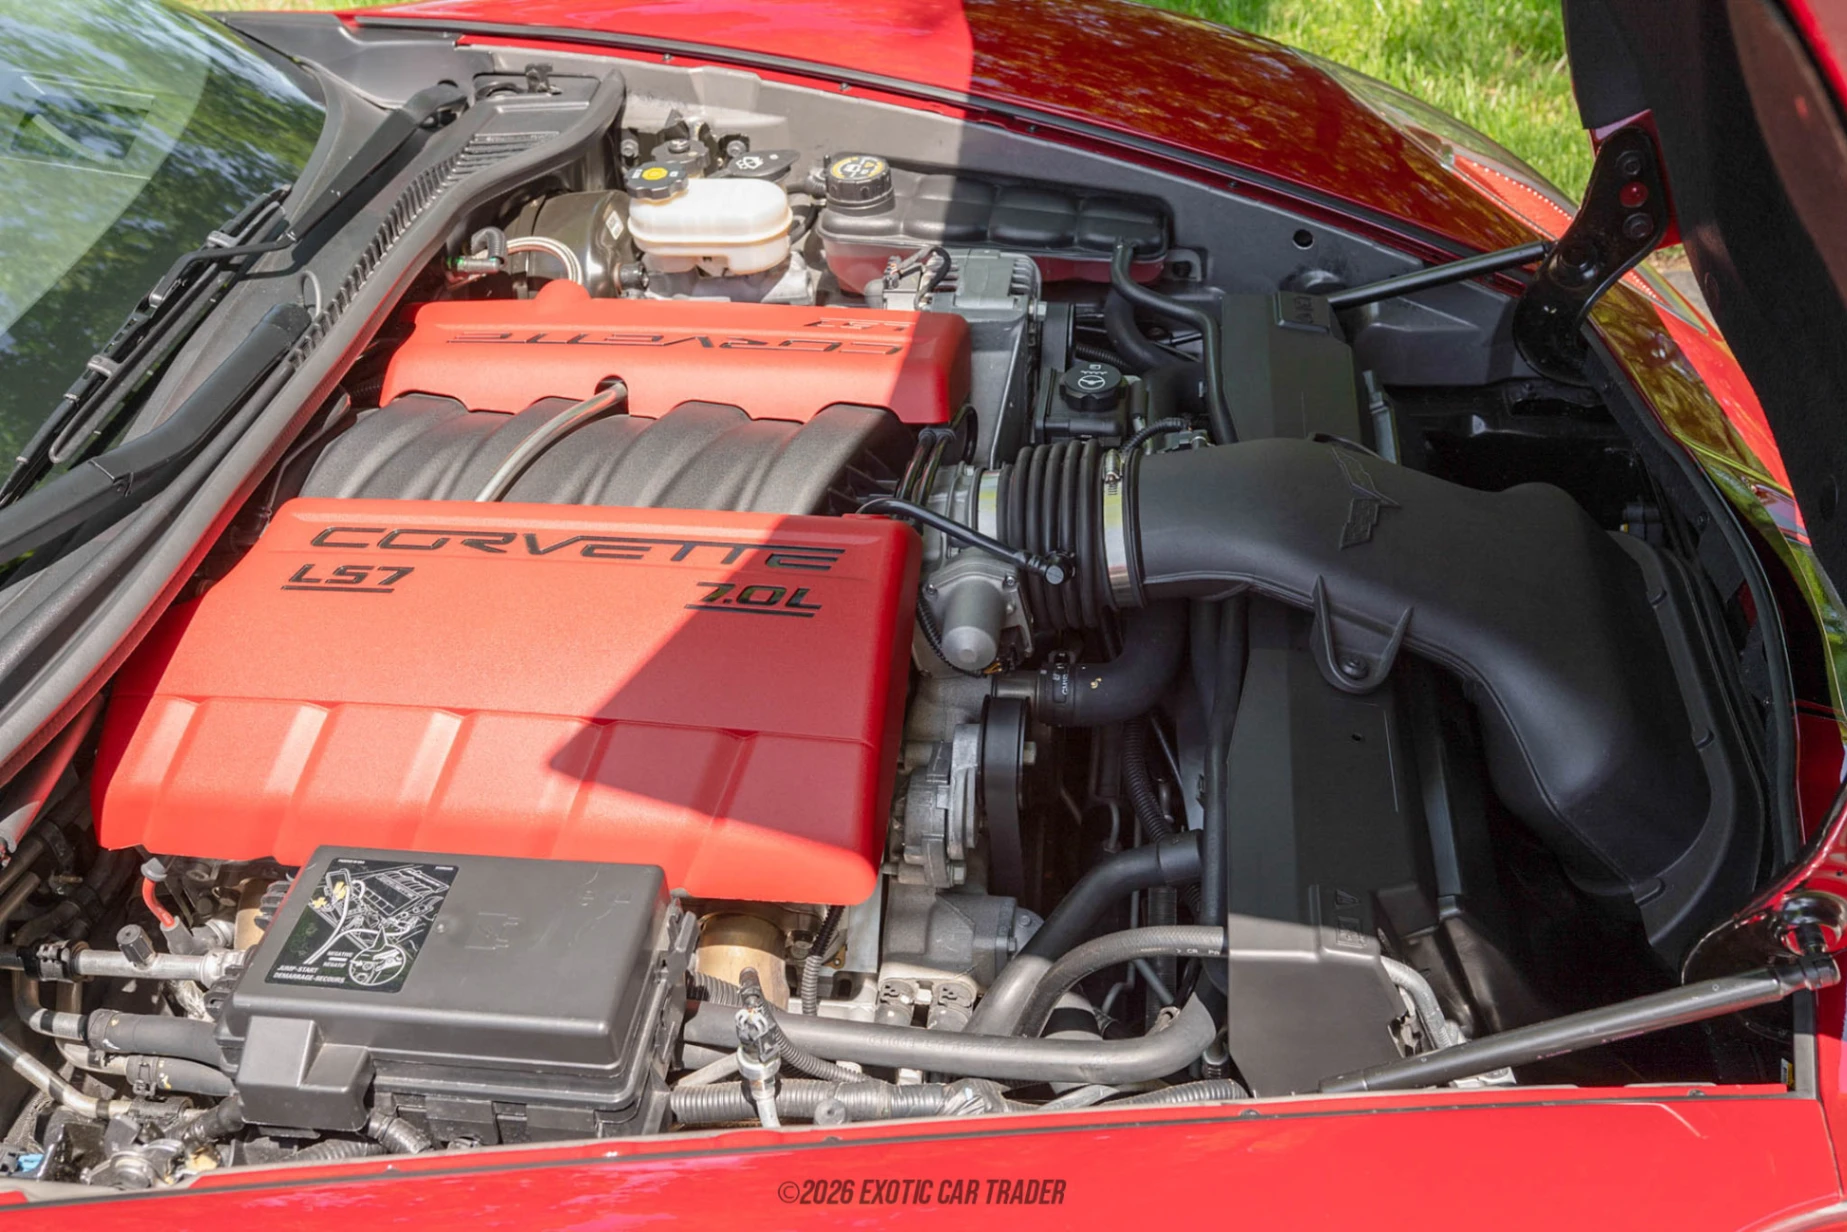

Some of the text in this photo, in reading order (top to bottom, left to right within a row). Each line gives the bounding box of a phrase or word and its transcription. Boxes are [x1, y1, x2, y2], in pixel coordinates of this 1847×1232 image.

[447, 333, 903, 355] CORVETTE
[310, 527, 845, 571] CORVETTE
[287, 563, 415, 586] LS7
[694, 582, 823, 612] 7.0L
[277, 965, 319, 973] JUMP-START
